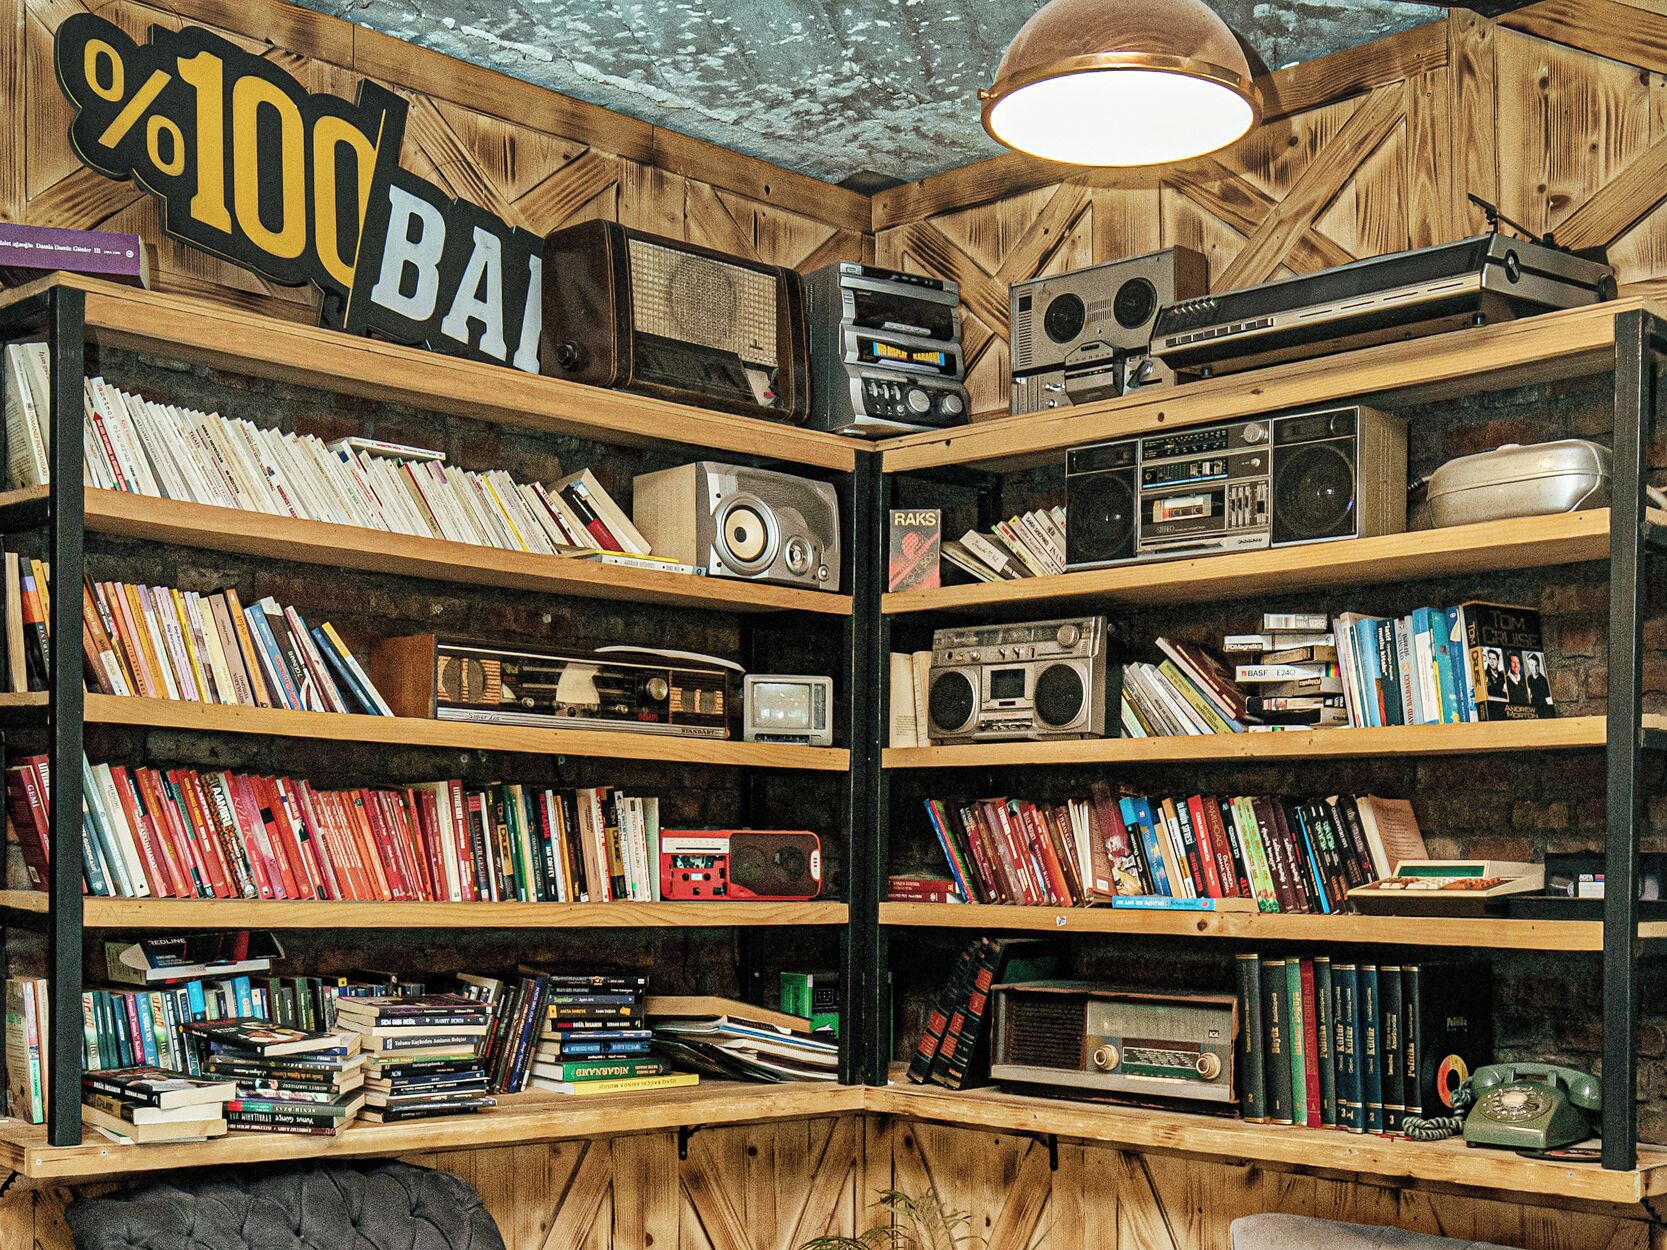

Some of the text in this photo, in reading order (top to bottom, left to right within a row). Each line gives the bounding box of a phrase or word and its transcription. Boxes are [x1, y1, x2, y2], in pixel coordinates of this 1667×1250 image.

[83, 38, 378, 289] %100
[36, 242, 54, 251] Damla
[54, 244, 72, 252] Damla
[894, 512, 936, 526] RAKS
[1492, 610, 1526, 631] TOM
[1468, 623, 1477, 646] TOM
[1482, 628, 1541, 648] CRUISE
[1504, 705, 1536, 714] ANDREW
[1506, 710, 1539, 720] MORTON
[545, 856, 556, 877] COFFEY
[140, 1011, 153, 1042] ANDREWS
[1320, 1024, 1328, 1058] Politika
[1336, 1023, 1344, 1052] Kültür
[1344, 1025, 1352, 1054] Kültür
[1366, 1026, 1375, 1055] Kültür
[1406, 1042, 1415, 1077] Politika
[295, 1116, 314, 1124] Yunus
[1370, 1112, 1375, 1122] 2
[1389, 1115, 1395, 1125] 3
